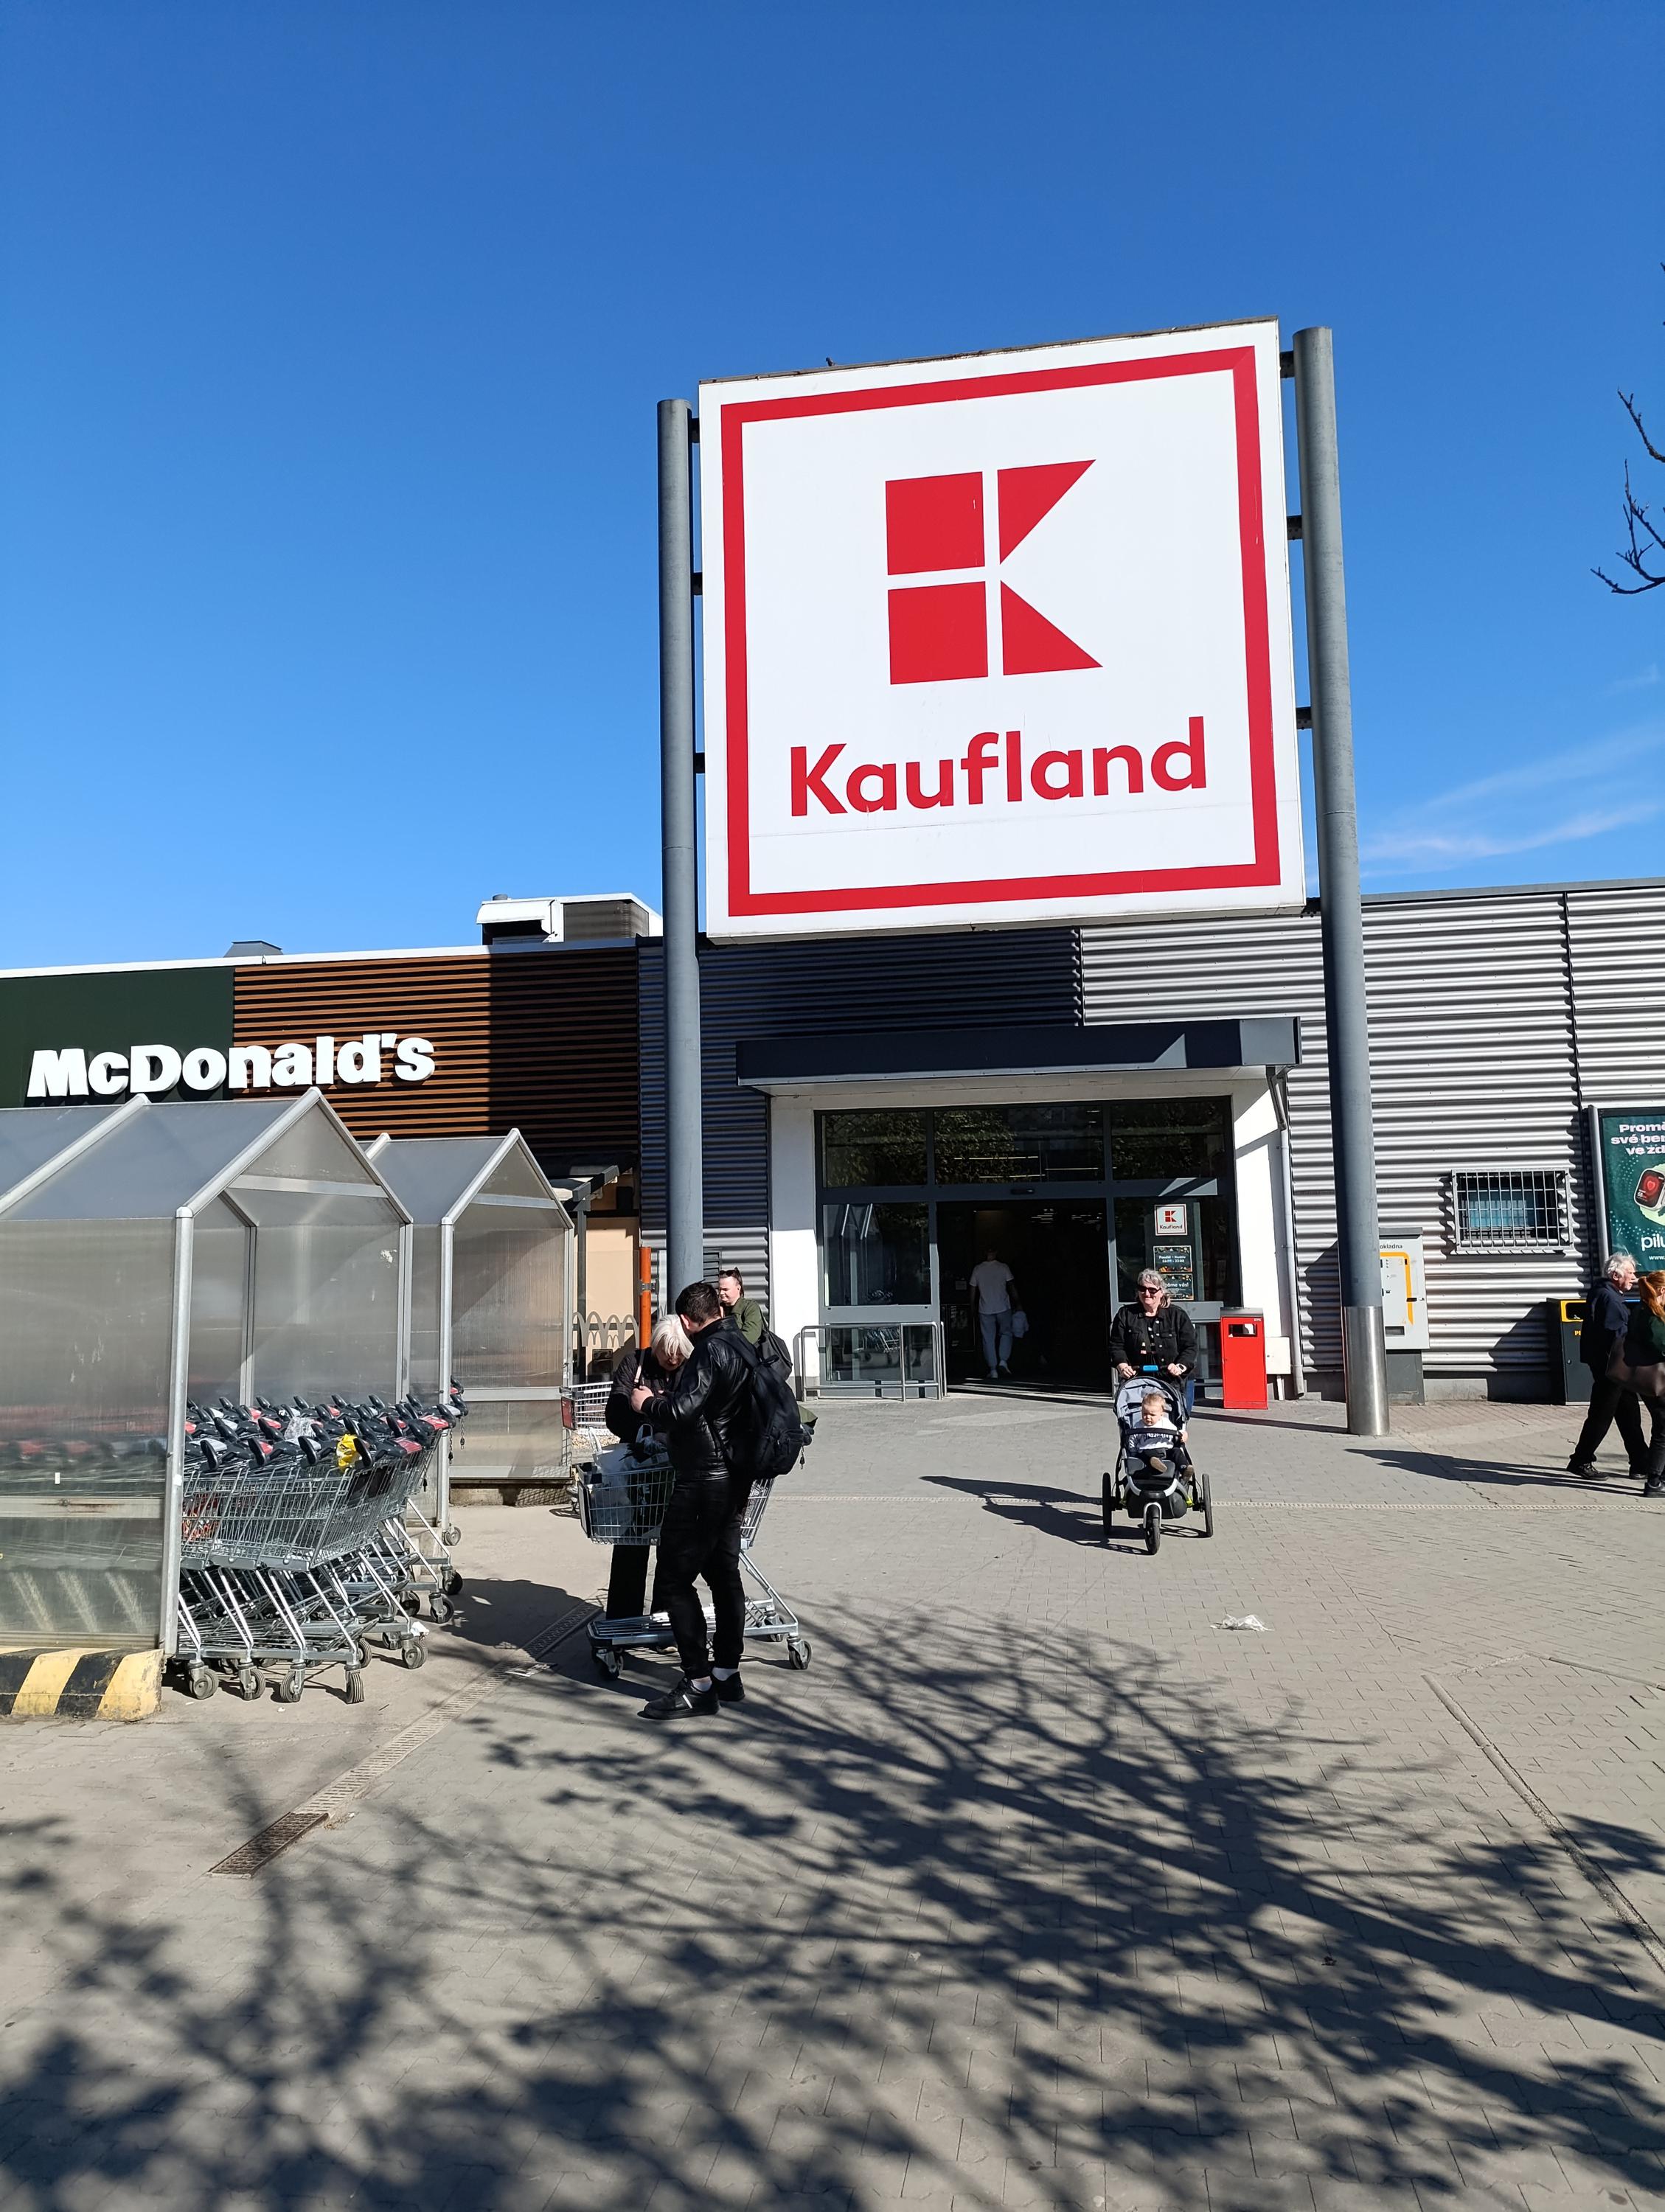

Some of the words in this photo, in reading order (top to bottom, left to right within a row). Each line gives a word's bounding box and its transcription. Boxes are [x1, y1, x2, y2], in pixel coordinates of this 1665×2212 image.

[790, 716, 1206, 817] Kaufland
[26, 1032, 436, 1098] McDonald's
[1611, 1134, 1638, 1144] své
[1625, 1147, 1645, 1155] ve
